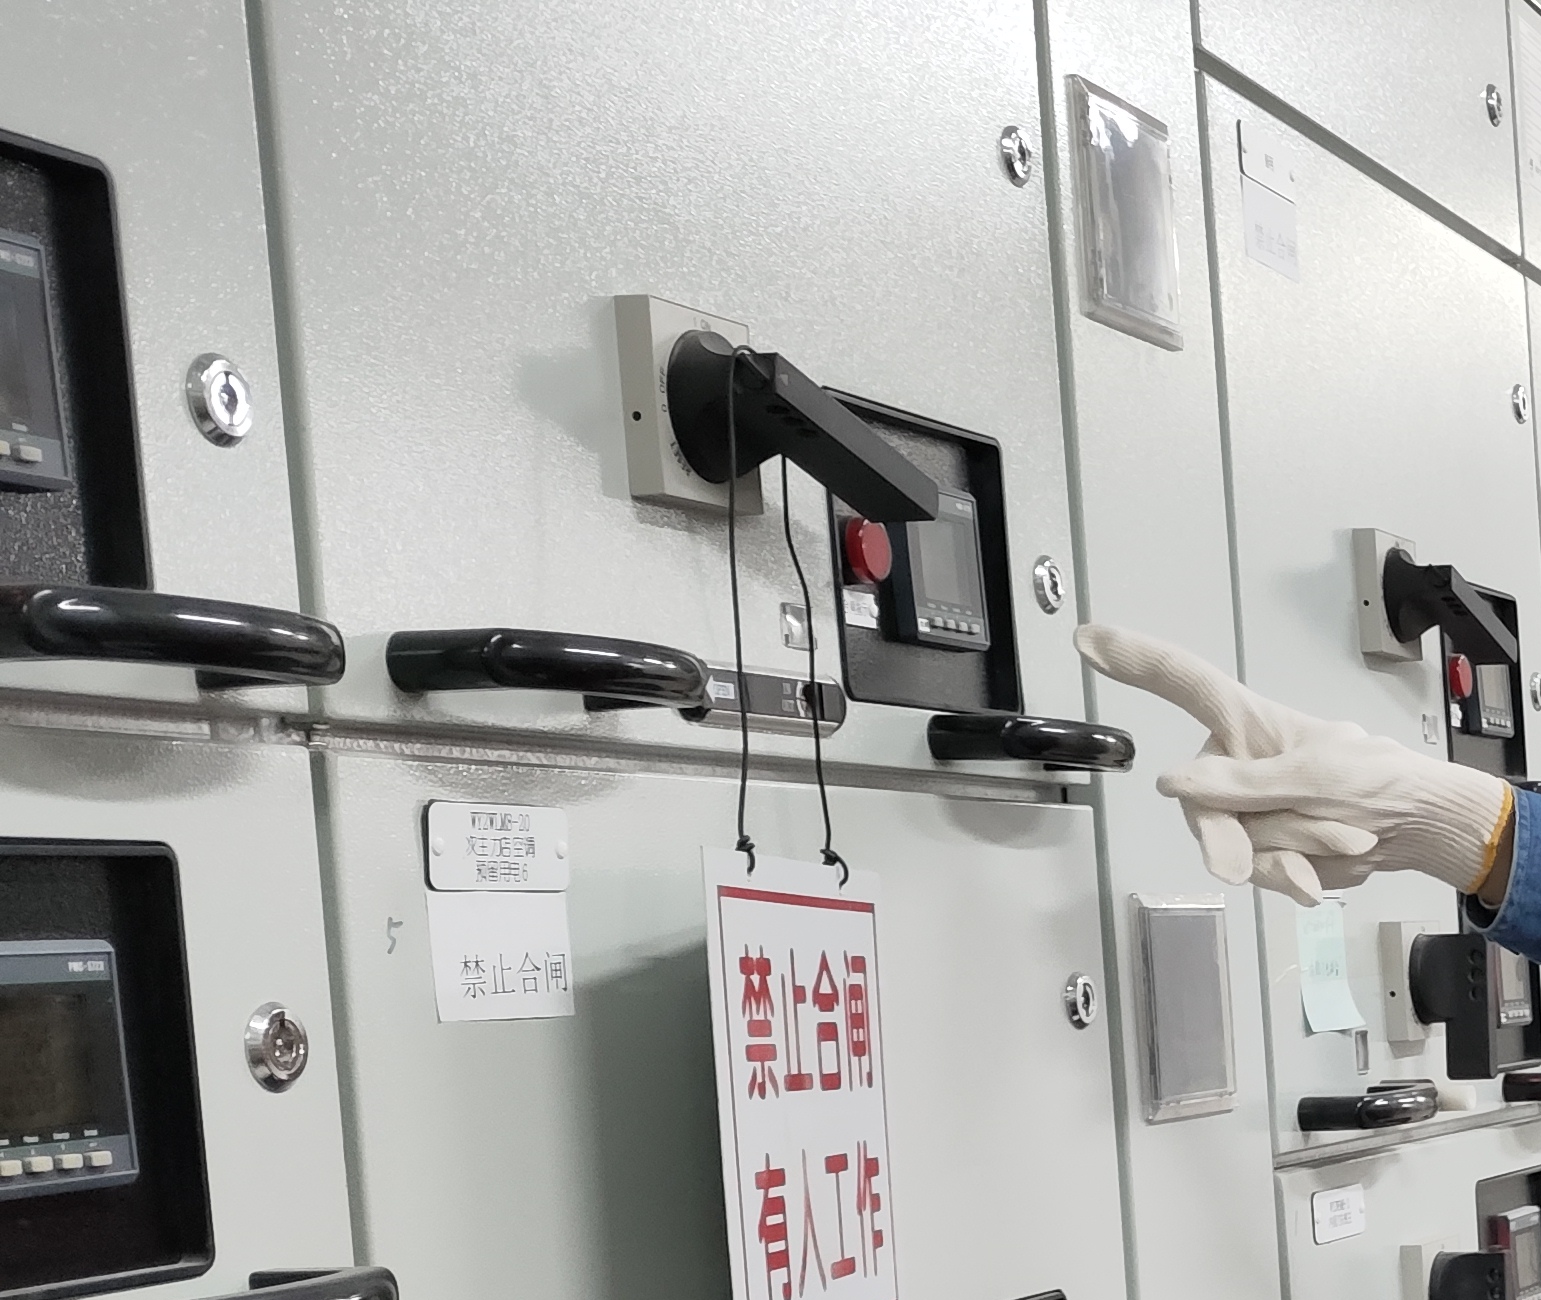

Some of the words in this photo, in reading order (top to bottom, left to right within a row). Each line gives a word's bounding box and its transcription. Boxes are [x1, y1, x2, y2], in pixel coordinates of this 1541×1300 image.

[460, 951, 568, 999] 禁止合闸
[739, 943, 876, 1101] 禁止合闸
